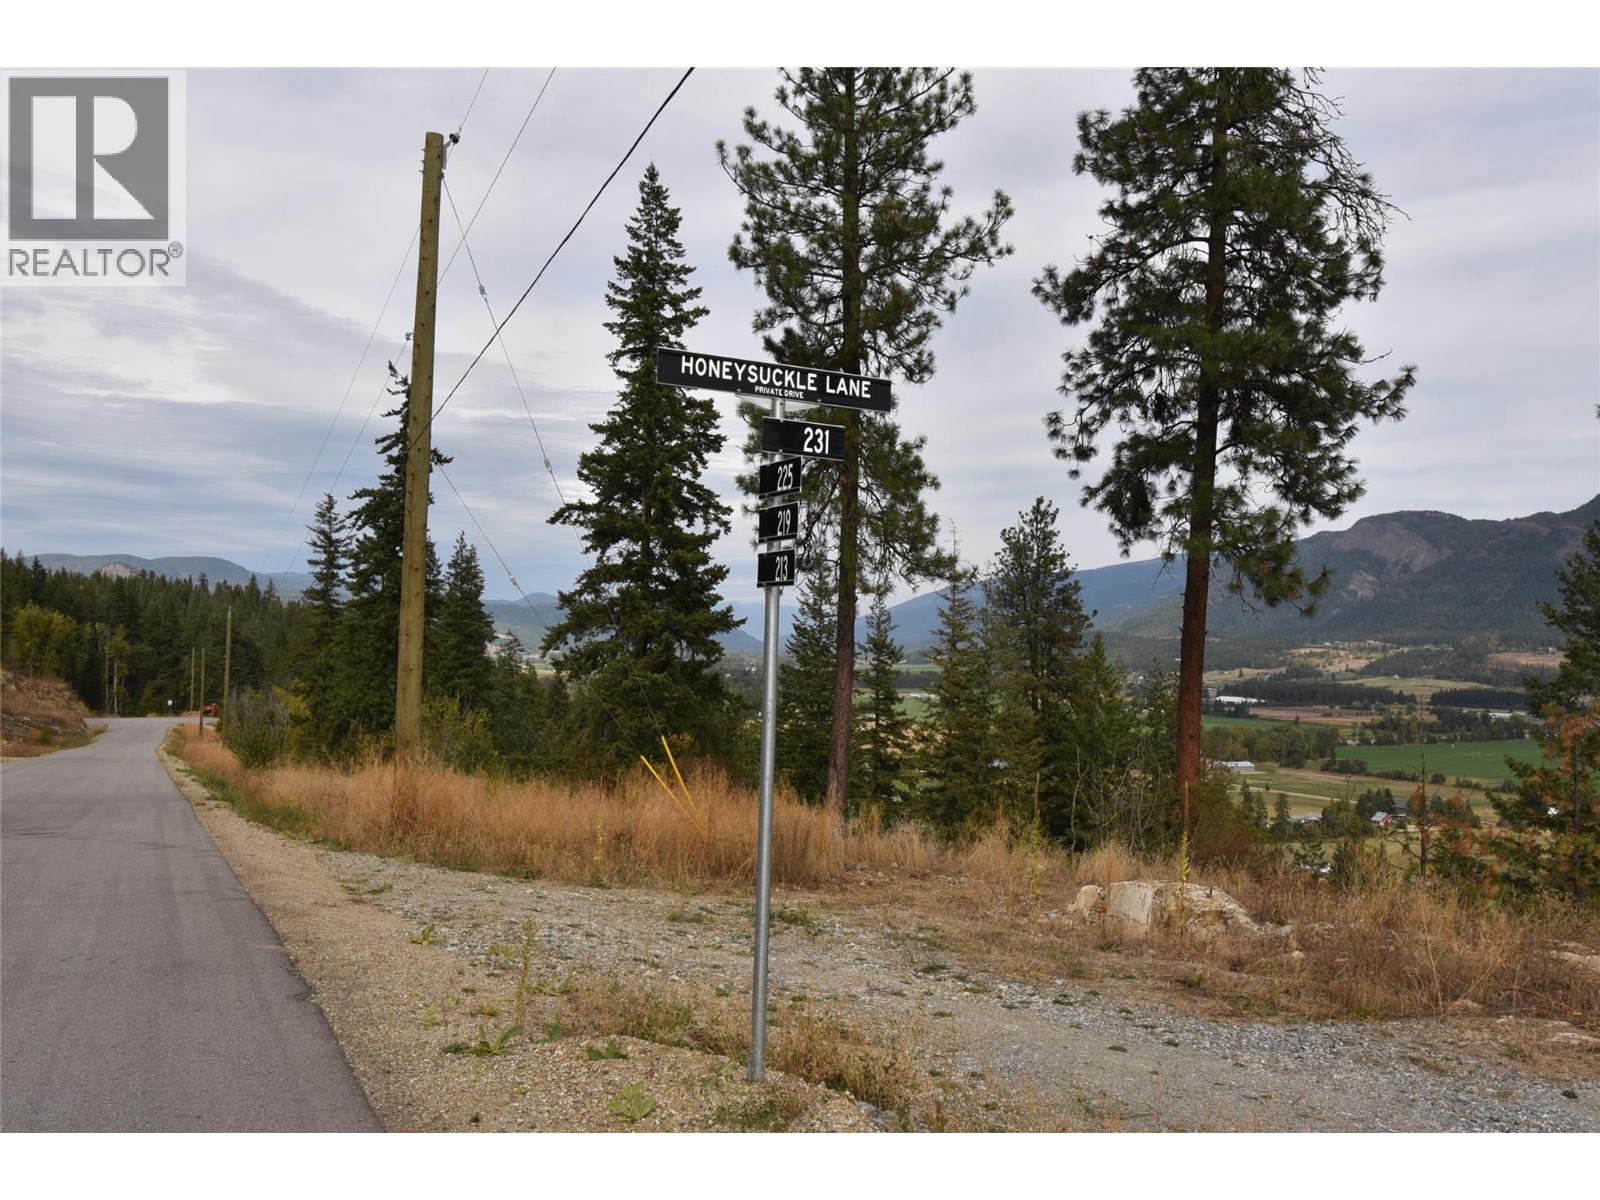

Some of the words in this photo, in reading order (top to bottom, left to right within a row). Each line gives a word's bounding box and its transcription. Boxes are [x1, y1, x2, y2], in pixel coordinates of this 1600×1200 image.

[681, 355, 818, 391] HONEYSUCKLE
[826, 375, 872, 399] LANE
[754, 385, 783, 397] PRIVATE
[784, 389, 804, 400] DRIVE
[803, 426, 830, 455] 231
[777, 463, 793, 491] 225
[777, 509, 791, 537] 219
[775, 555, 789, 581] 213
